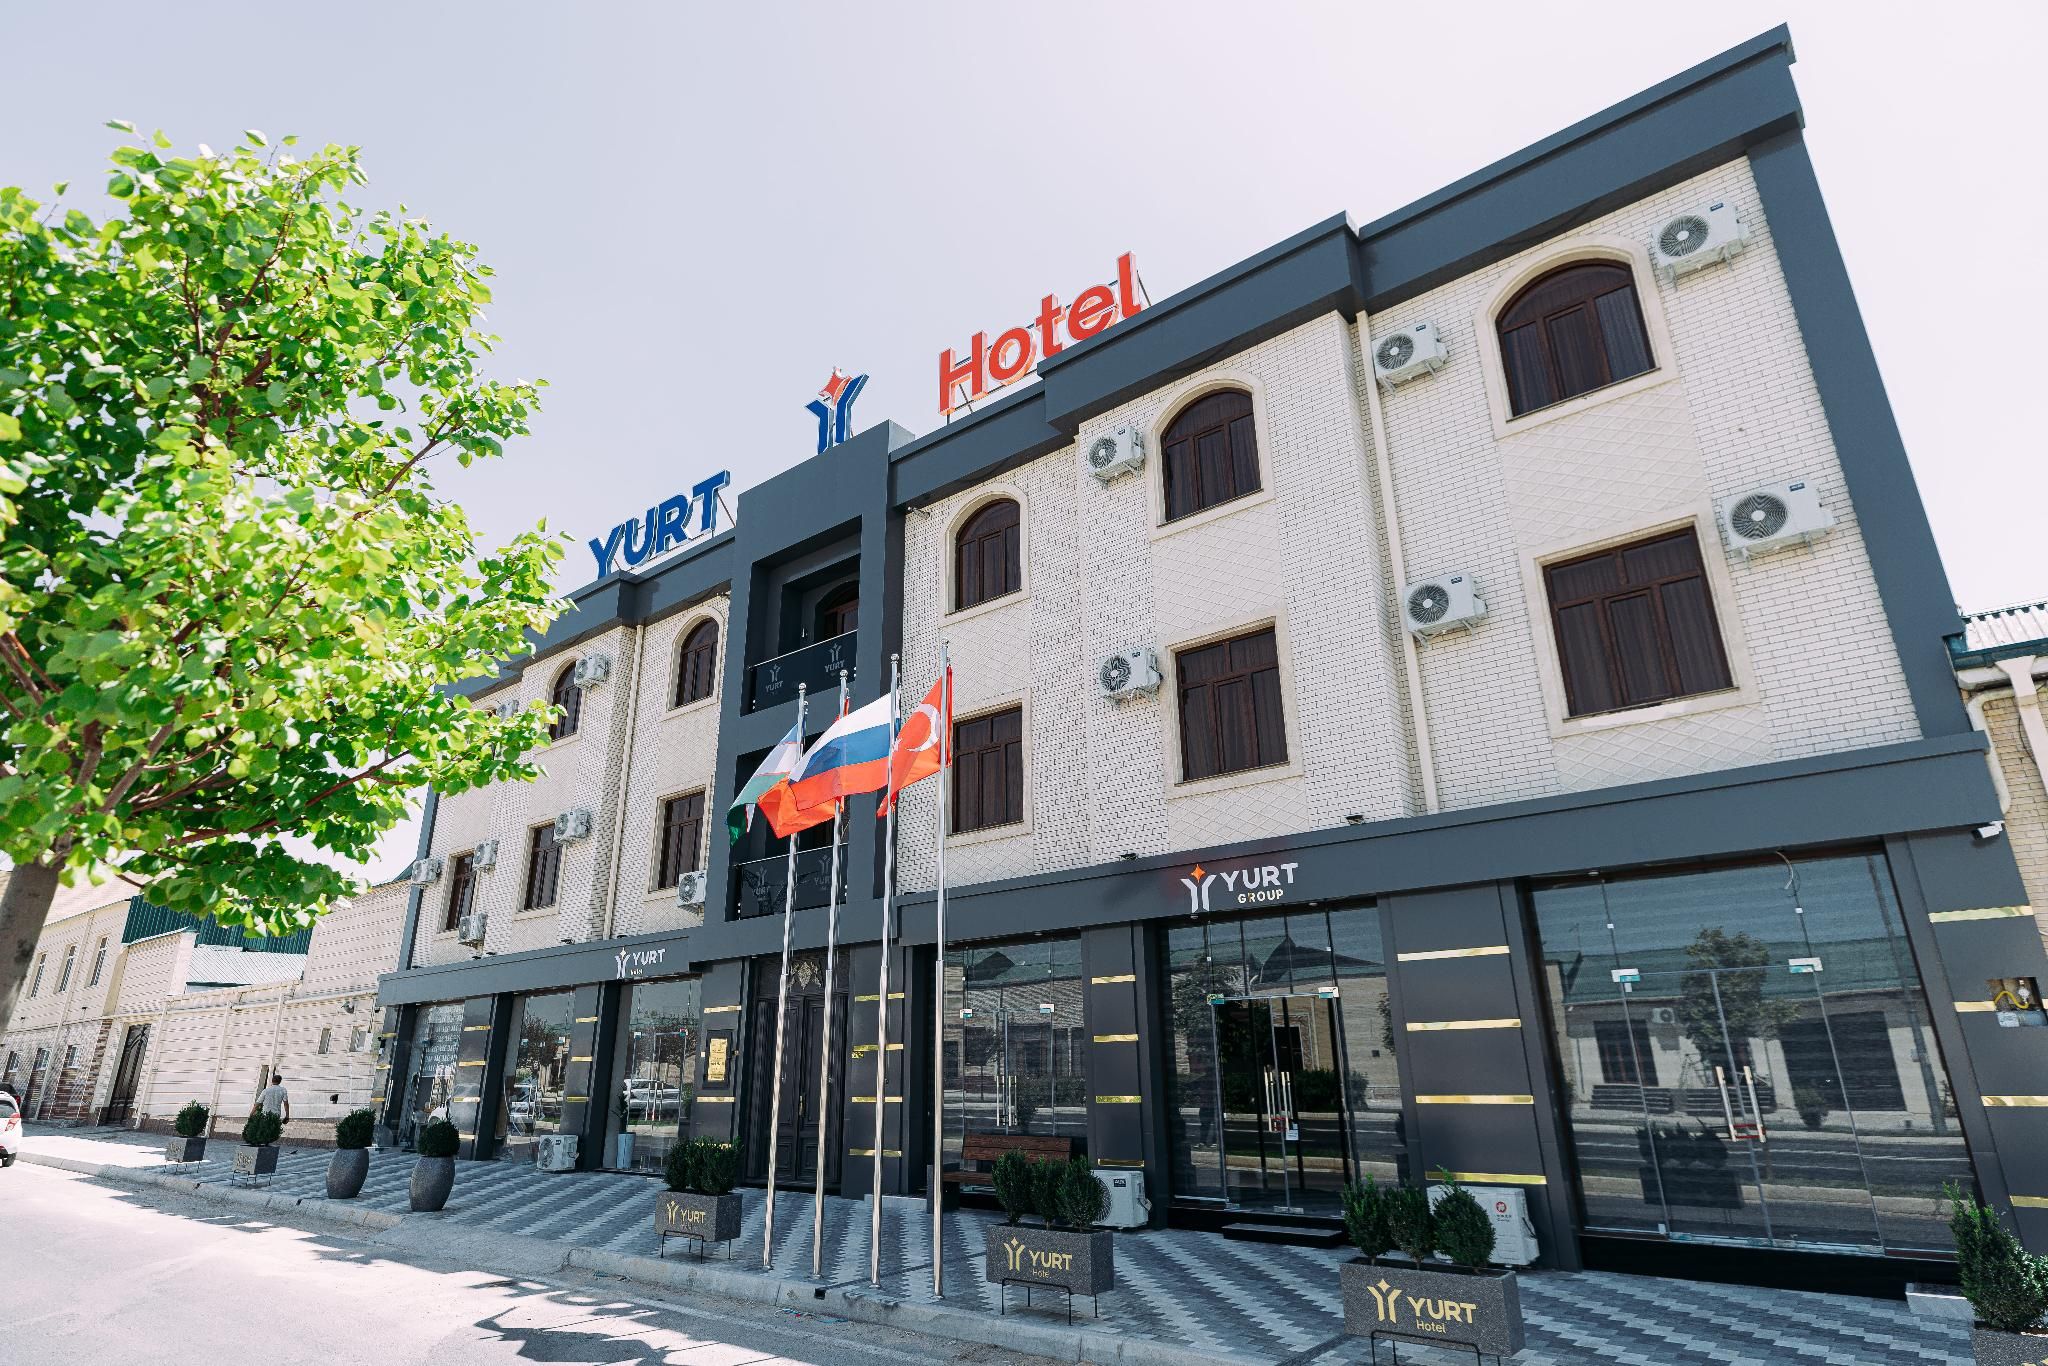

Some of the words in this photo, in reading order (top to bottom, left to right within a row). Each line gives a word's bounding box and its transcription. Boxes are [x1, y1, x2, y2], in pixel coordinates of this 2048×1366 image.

[588, 469, 730, 580] YURT
[939, 250, 1142, 416] Hotel
[765, 680, 784, 693] YURT
[1219, 862, 1299, 892] YURT
[1238, 888, 1284, 904] GROUP
[632, 948, 666, 966] YURT
[680, 1208, 706, 1224] YURT
[1029, 1249, 1073, 1271] YURT
[1406, 1296, 1477, 1324] YURT
[1416, 1319, 1447, 1334] Hotel
